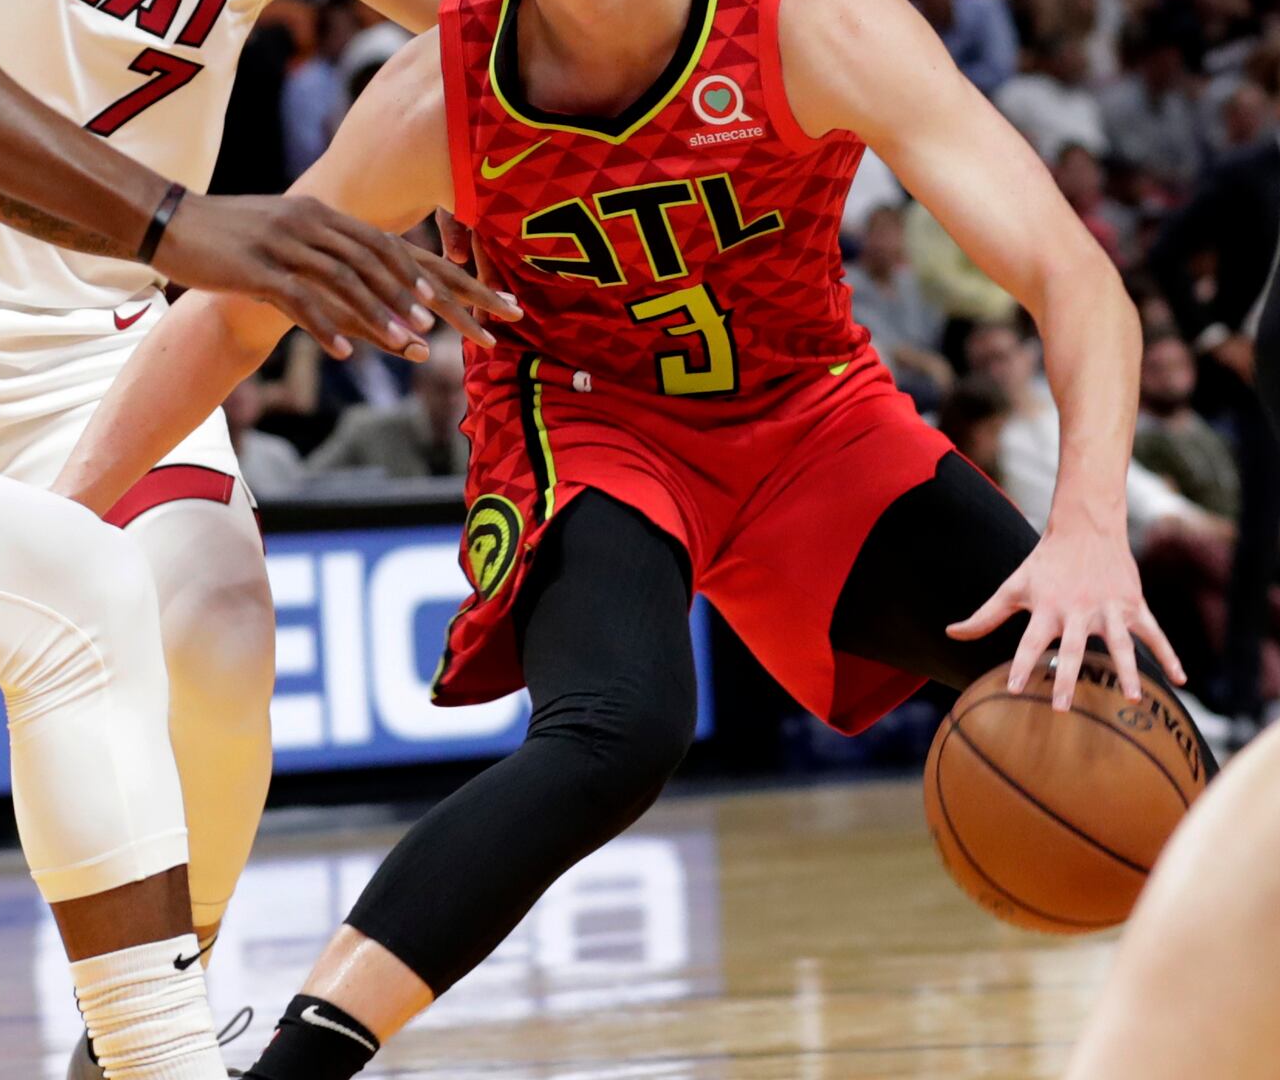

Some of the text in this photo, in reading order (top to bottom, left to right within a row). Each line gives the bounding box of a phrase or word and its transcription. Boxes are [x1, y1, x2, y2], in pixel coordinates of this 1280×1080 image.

[83, 47, 205, 138] 7
[689, 127, 763, 147] sharecare
[521, 172, 785, 289] ATL
[624, 281, 734, 396] 3
